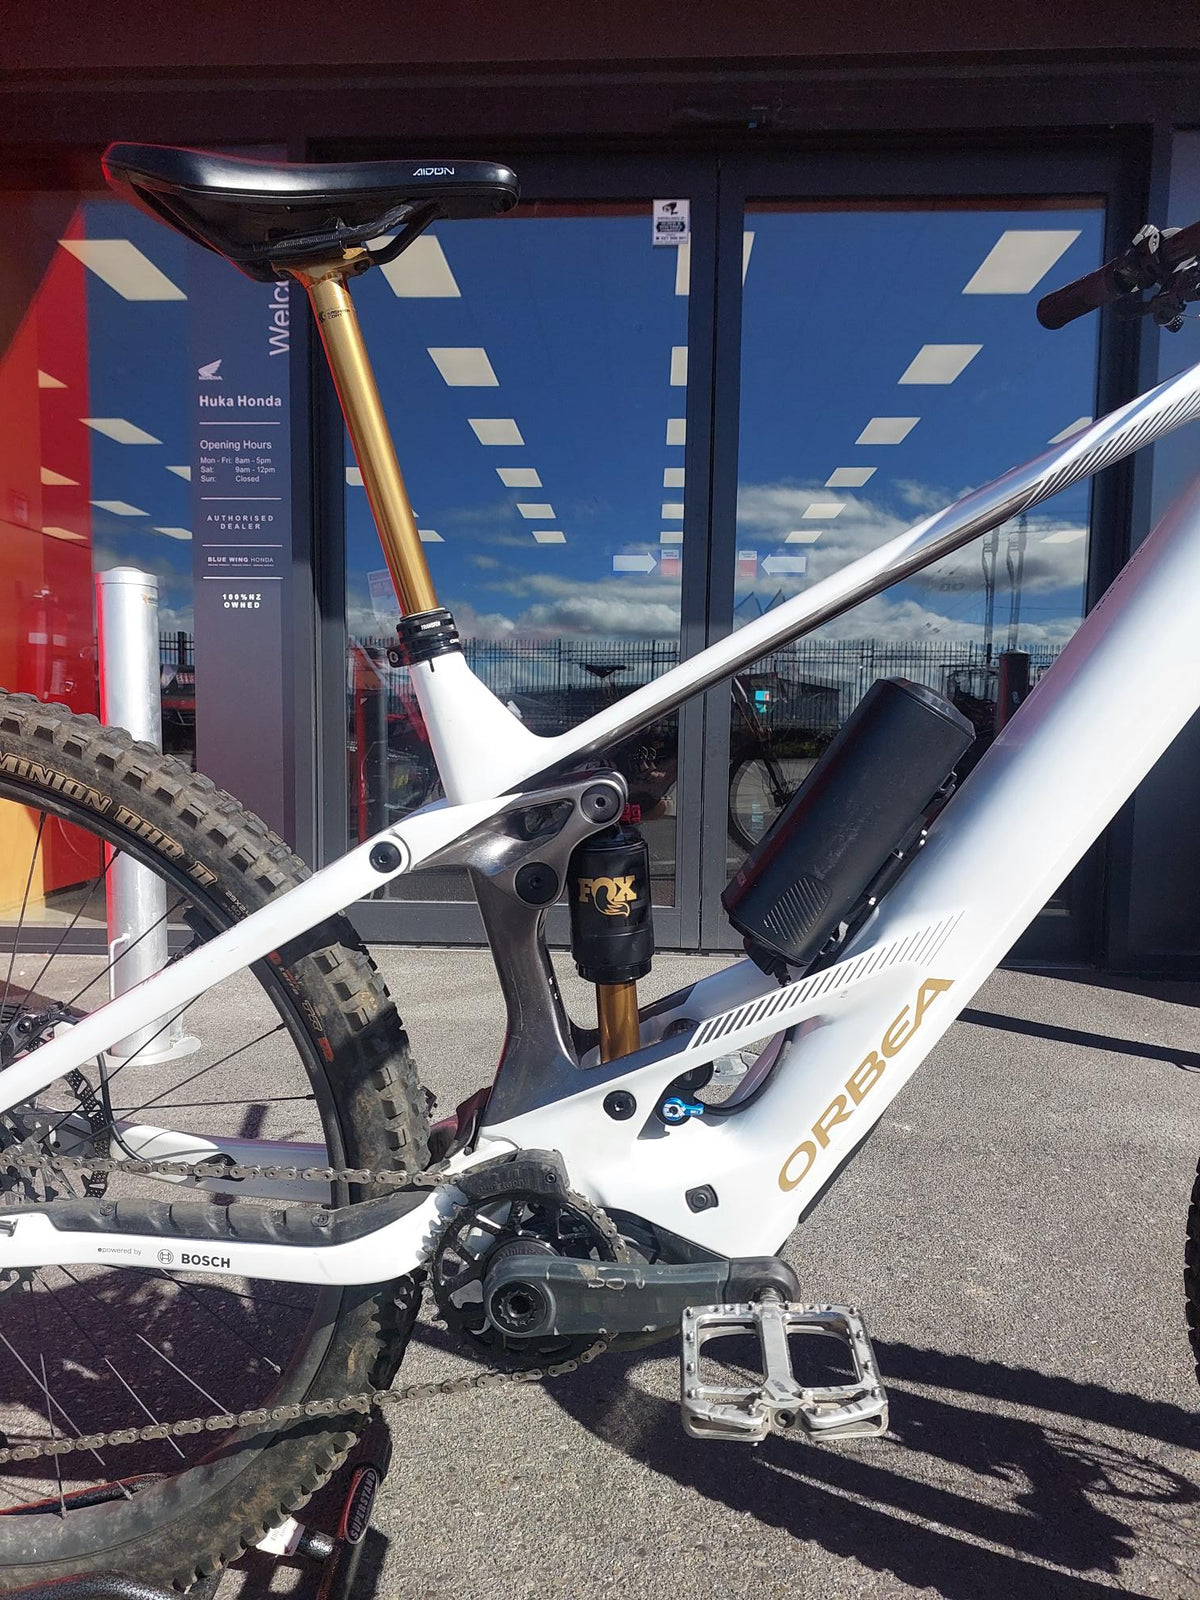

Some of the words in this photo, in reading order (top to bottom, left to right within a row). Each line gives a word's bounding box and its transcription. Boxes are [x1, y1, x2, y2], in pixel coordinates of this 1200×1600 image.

[412, 167, 455, 176] AIDON
[199, 395, 234, 407] Huka
[237, 395, 282, 407] Honda
[200, 439, 241, 452] Opening
[243, 439, 272, 450] Hours
[200, 456, 216, 464] Mon
[221, 456, 233, 464] Fri:
[235, 456, 250, 464] 8am
[256, 456, 272, 466] 5pm
[200, 465, 215, 474] Sat:
[235, 465, 251, 474] 9am
[257, 466, 276, 475] 12pm
[200, 474, 216, 483] Sun:
[235, 474, 260, 483] Closed
[206, 514, 274, 522] AUTHORISED
[223, 601, 260, 609] OWNED
[113, 805, 185, 860] DHR
[578, 875, 637, 913] FOX
[777, 977, 956, 1193] ORBEA
[181, 1253, 231, 1269] BOSCH
[349, 1471, 376, 1540] SUPERSTAND
